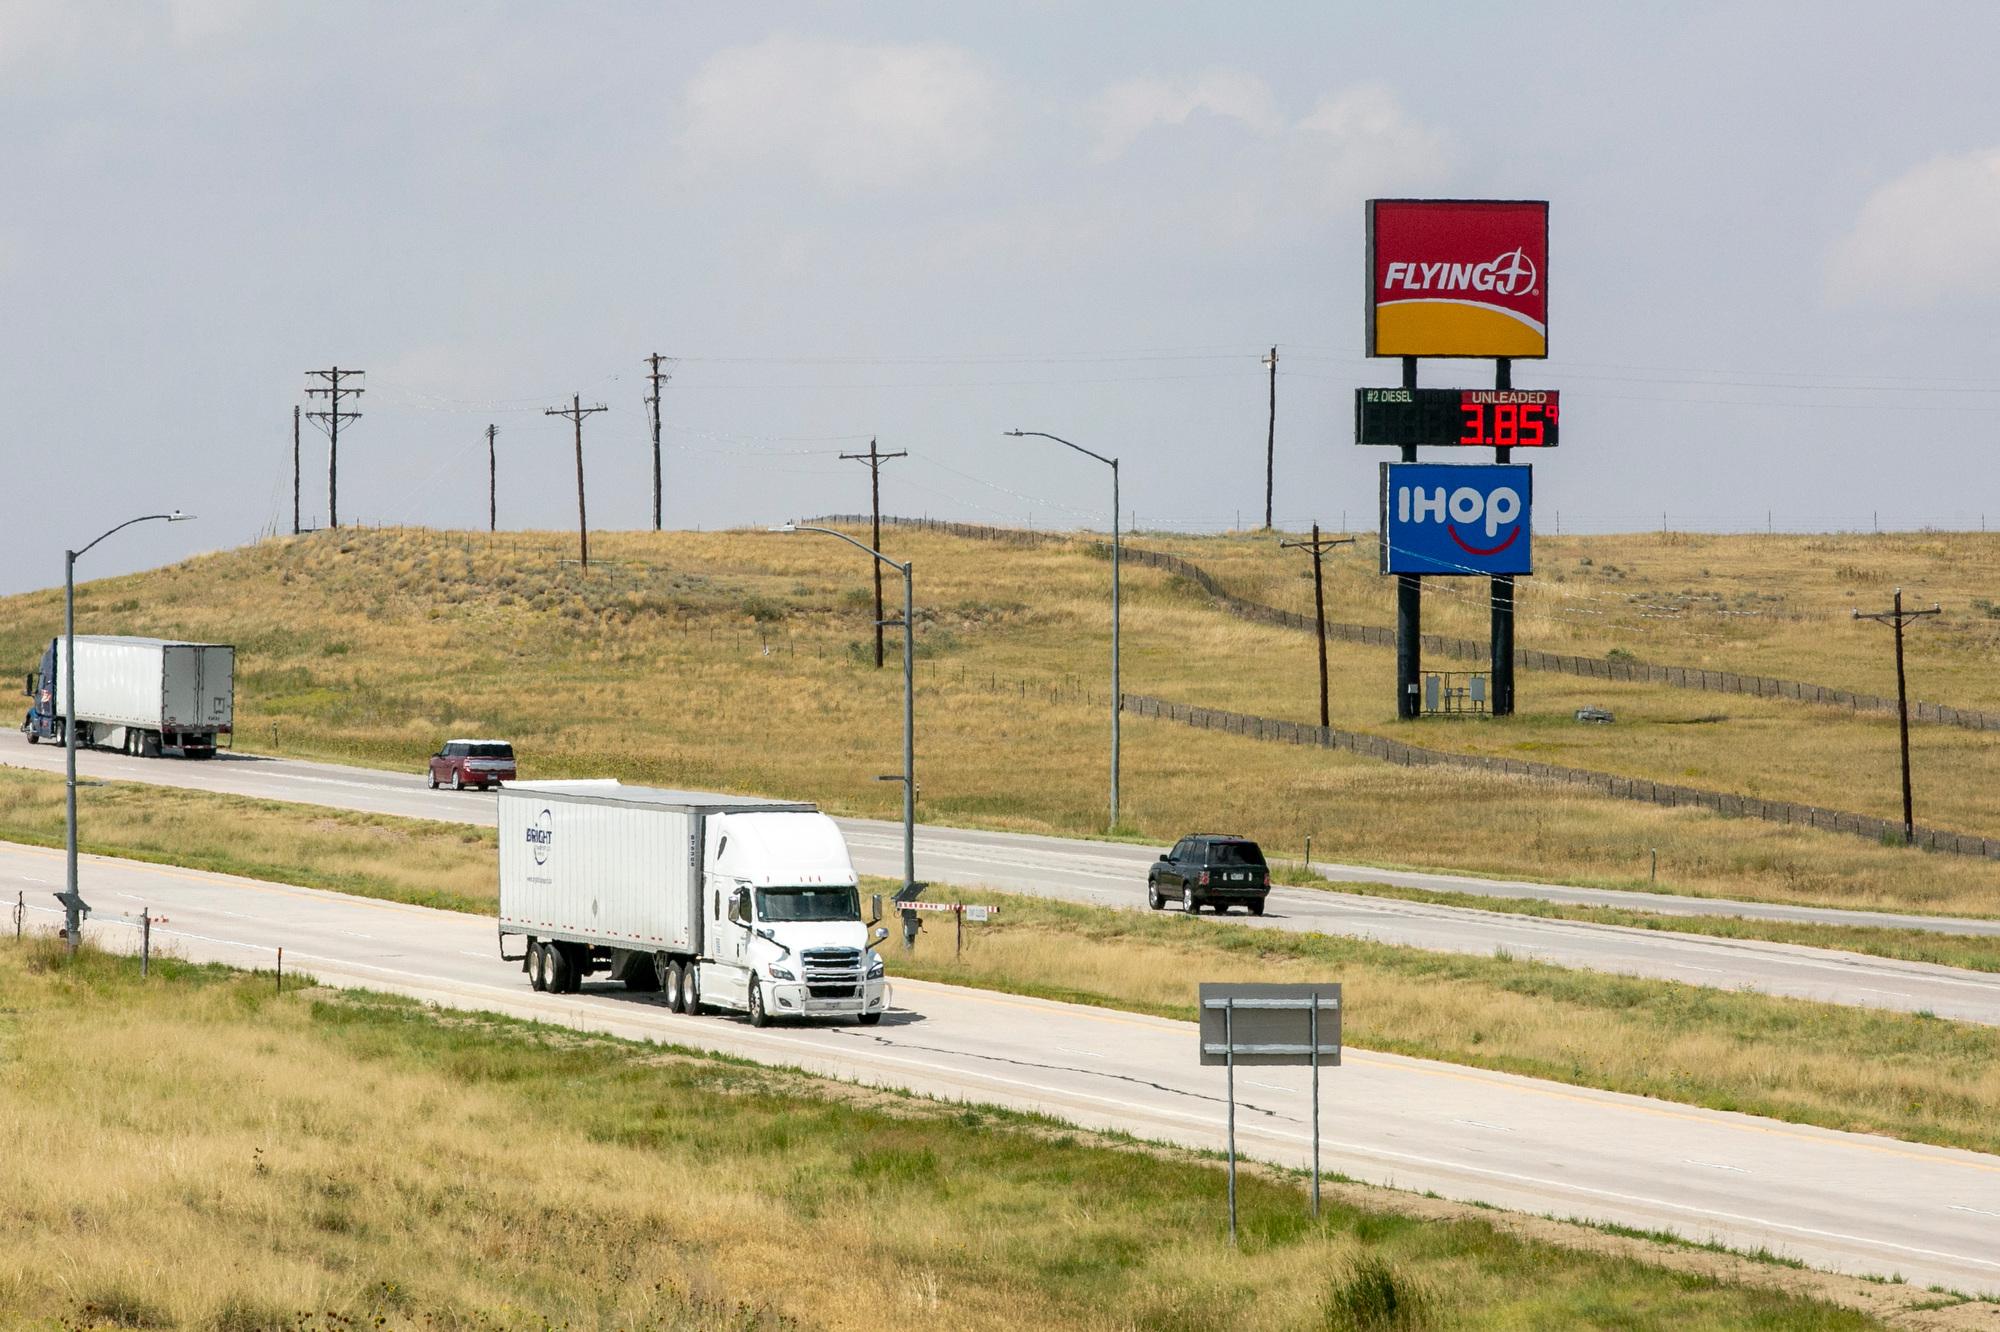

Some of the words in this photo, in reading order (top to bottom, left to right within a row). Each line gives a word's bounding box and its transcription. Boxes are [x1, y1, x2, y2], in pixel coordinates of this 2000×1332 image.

[1367, 390, 1379, 402] #2
[1381, 390, 1412, 402] DIESEL
[1472, 391, 1547, 404] UNLEADED
[1398, 486, 1521, 537] IHOP
[526, 828, 552, 844] BRIGHT
